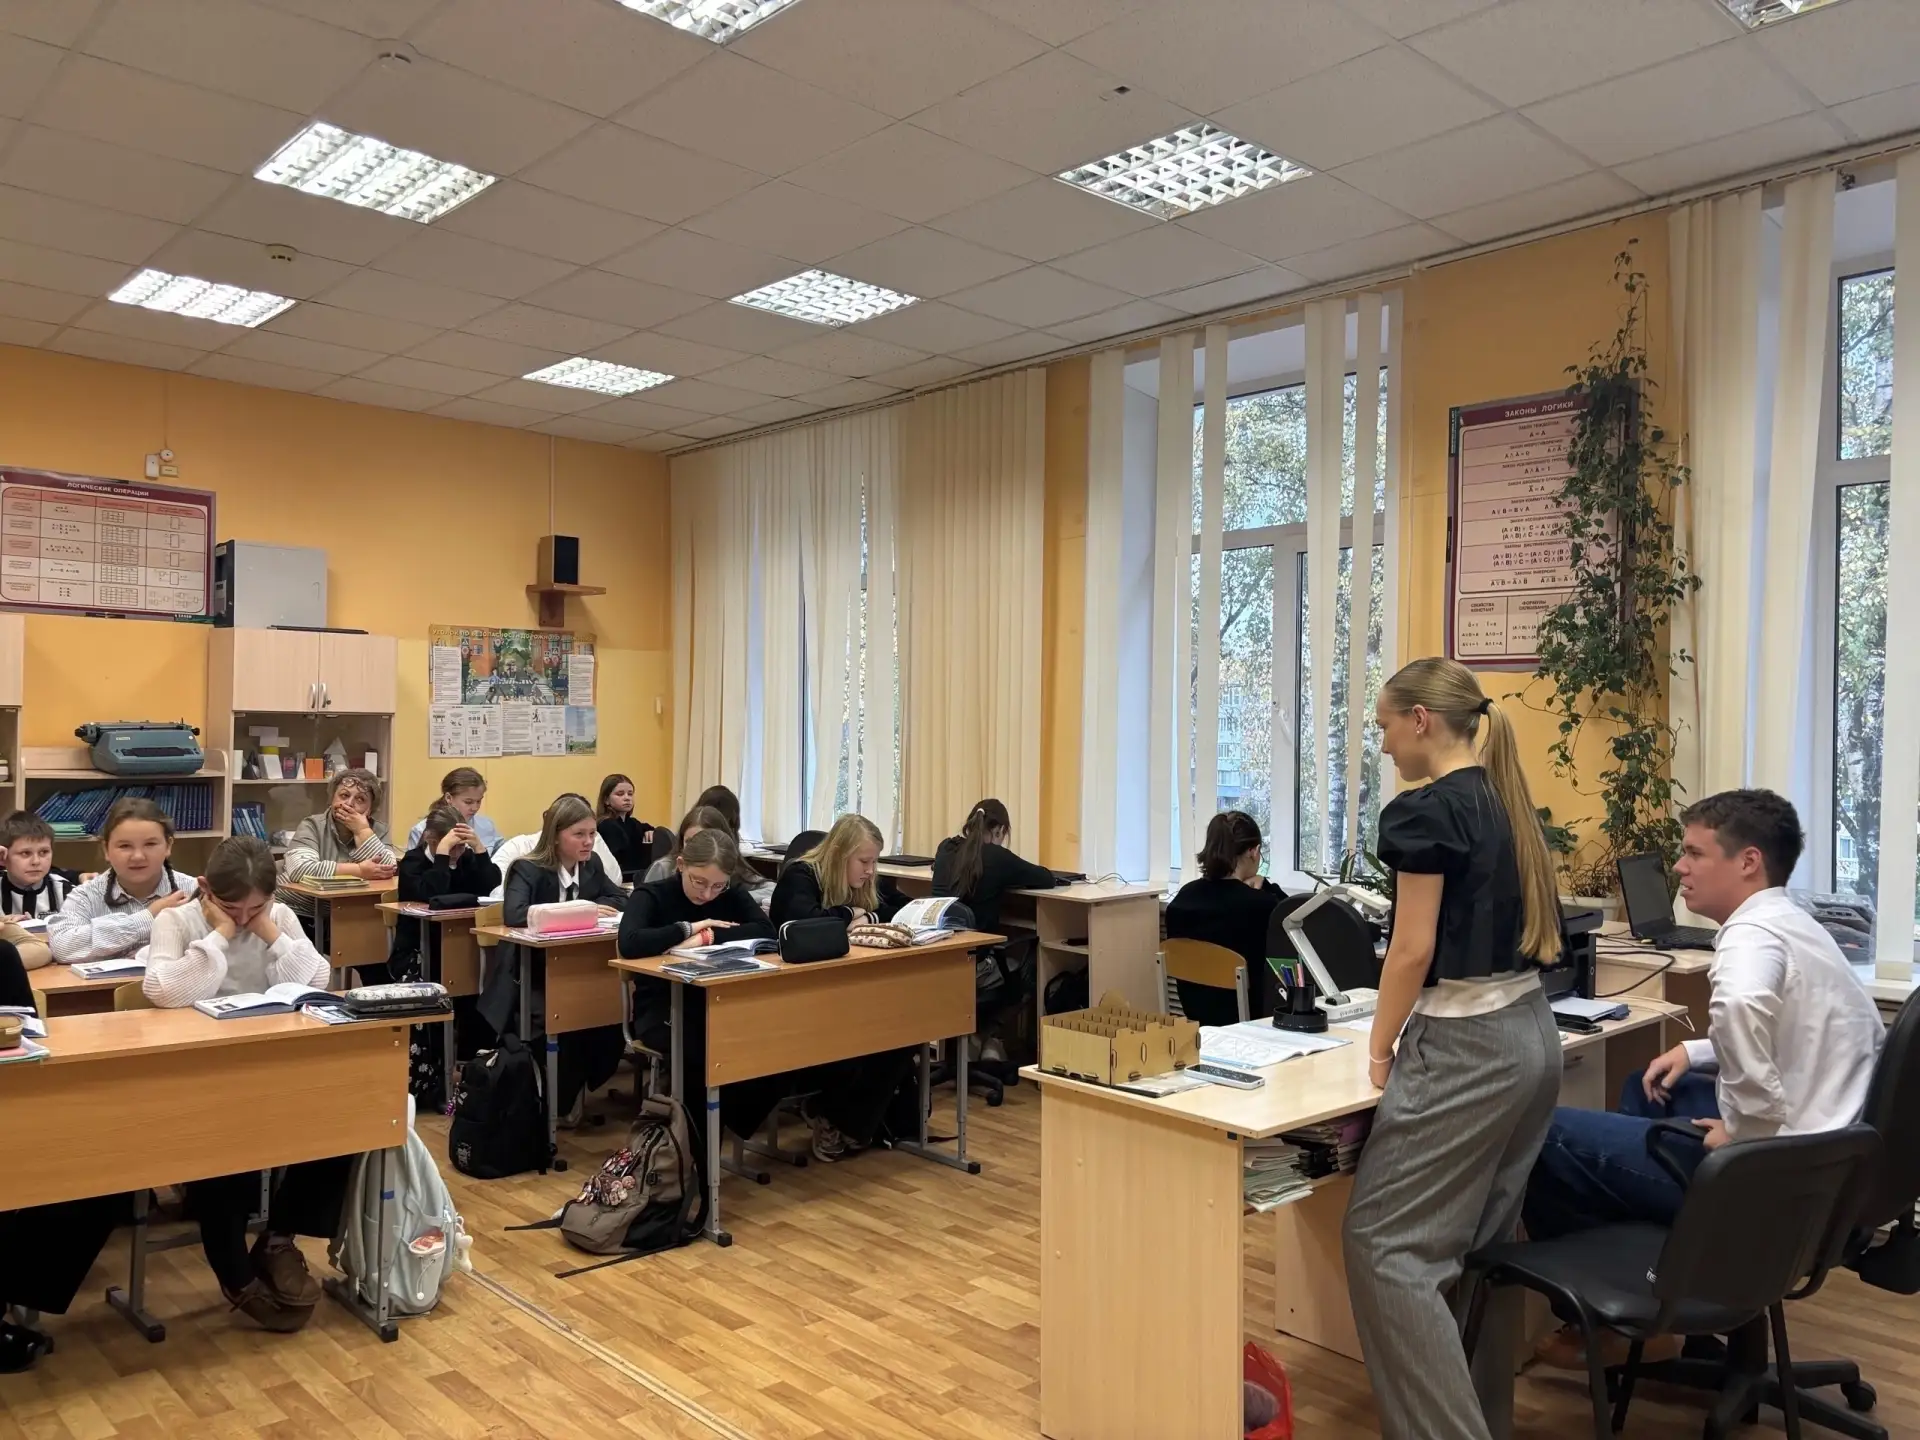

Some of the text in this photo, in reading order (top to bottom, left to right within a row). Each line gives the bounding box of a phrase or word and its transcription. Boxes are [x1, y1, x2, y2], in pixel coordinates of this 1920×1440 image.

[1505, 401, 1574, 417] ЗАКОНЫ ЛОГИКИ
[67, 482, 149, 496] ЛОГИЧЕСКИЕ ОПЕРАЦИИ
